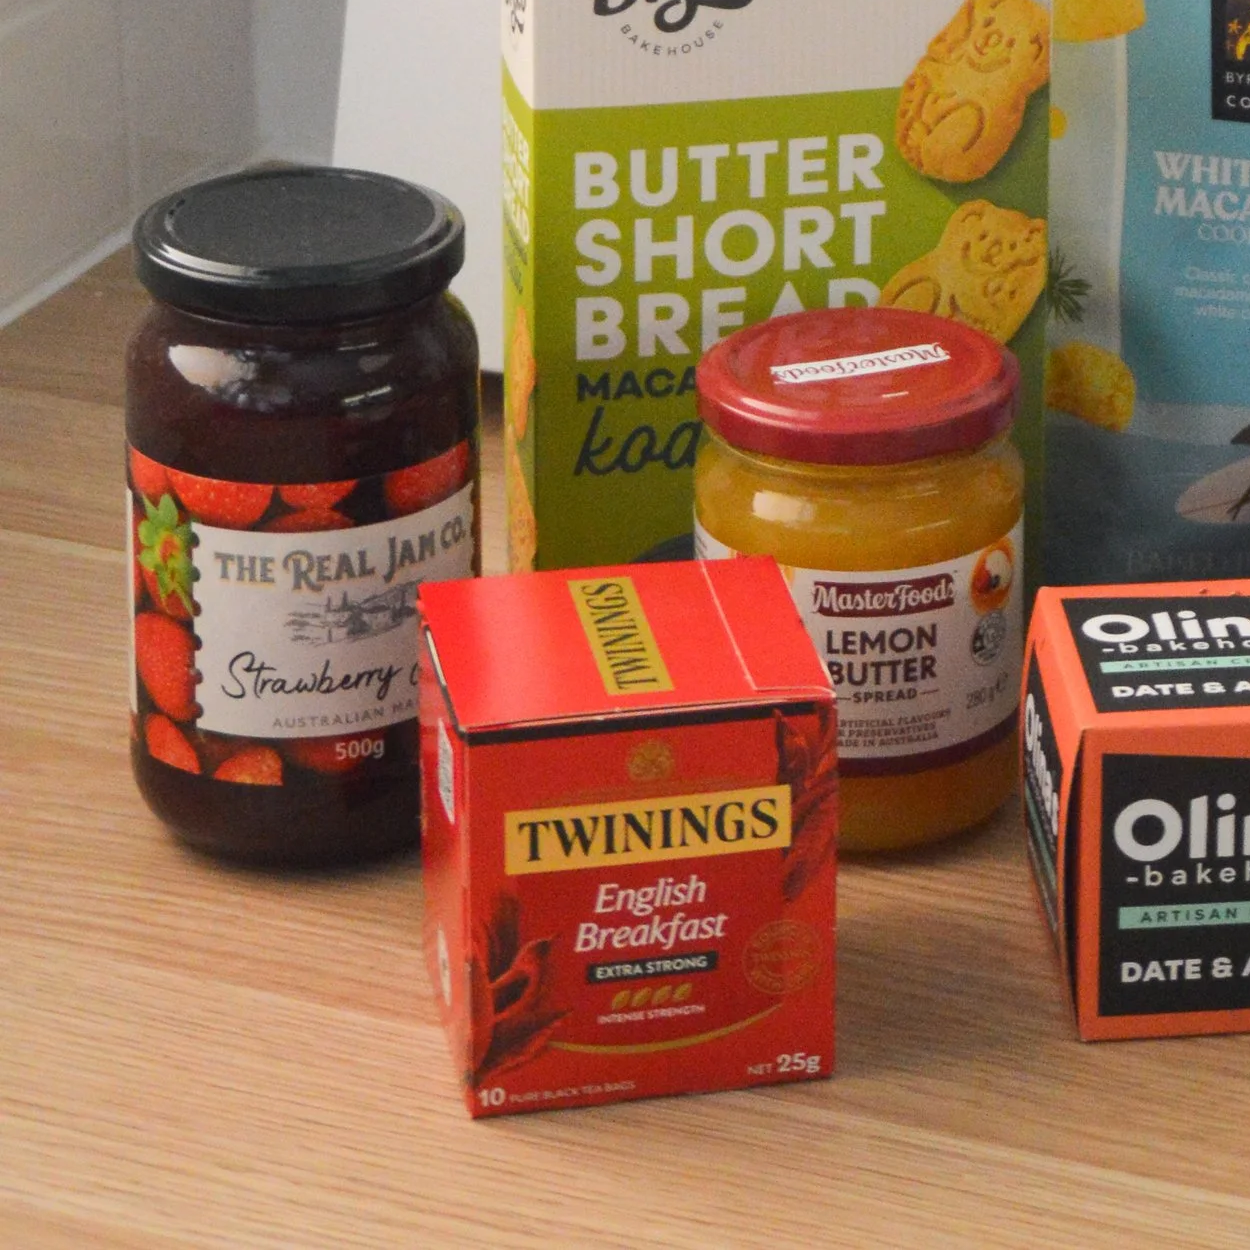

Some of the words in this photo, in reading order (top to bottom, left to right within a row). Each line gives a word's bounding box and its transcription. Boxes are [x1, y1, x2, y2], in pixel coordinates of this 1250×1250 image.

[619, 18, 726, 57] BAKEHOUSE
[574, 133, 885, 210] BUTTER
[574, 200, 887, 287] SHORT
[213, 551, 276, 584] THE
[282, 549, 376, 593] REAL
[382, 531, 436, 584] JAM
[438, 514, 467, 551] CO.
[580, 582, 659, 690] TWININGS
[826, 623, 938, 655] LEMON
[221, 650, 403, 701] Strawberry
[827, 654, 937, 687] BUTTER
[1123, 658, 1219, 670] ARTISAN
[853, 687, 918, 704] SPREAD
[1111, 682, 1195, 699] DATE
[1202, 680, 1227, 694] &
[272, 707, 385, 730] AUSTRALIAN
[838, 718, 896, 729] RTIFICIAL
[334, 738, 385, 761] 500g
[879, 732, 939, 746] AUSTRALIA
[518, 797, 780, 863] TWININGS
[594, 874, 707, 917] English
[1139, 904, 1238, 924] ARTISAN
[573, 912, 729, 952] Breakfast
[595, 962, 643, 980] EXTRA
[646, 955, 708, 975] STRONG
[1120, 956, 1204, 985] DATE
[1210, 956, 1234, 978] &
[597, 1010, 645, 1025] INTENSE
[647, 1004, 706, 1021] STRENGTH
[747, 1062, 773, 1076] NET
[775, 1052, 822, 1075] 25g
[477, 1087, 506, 1108] 10
